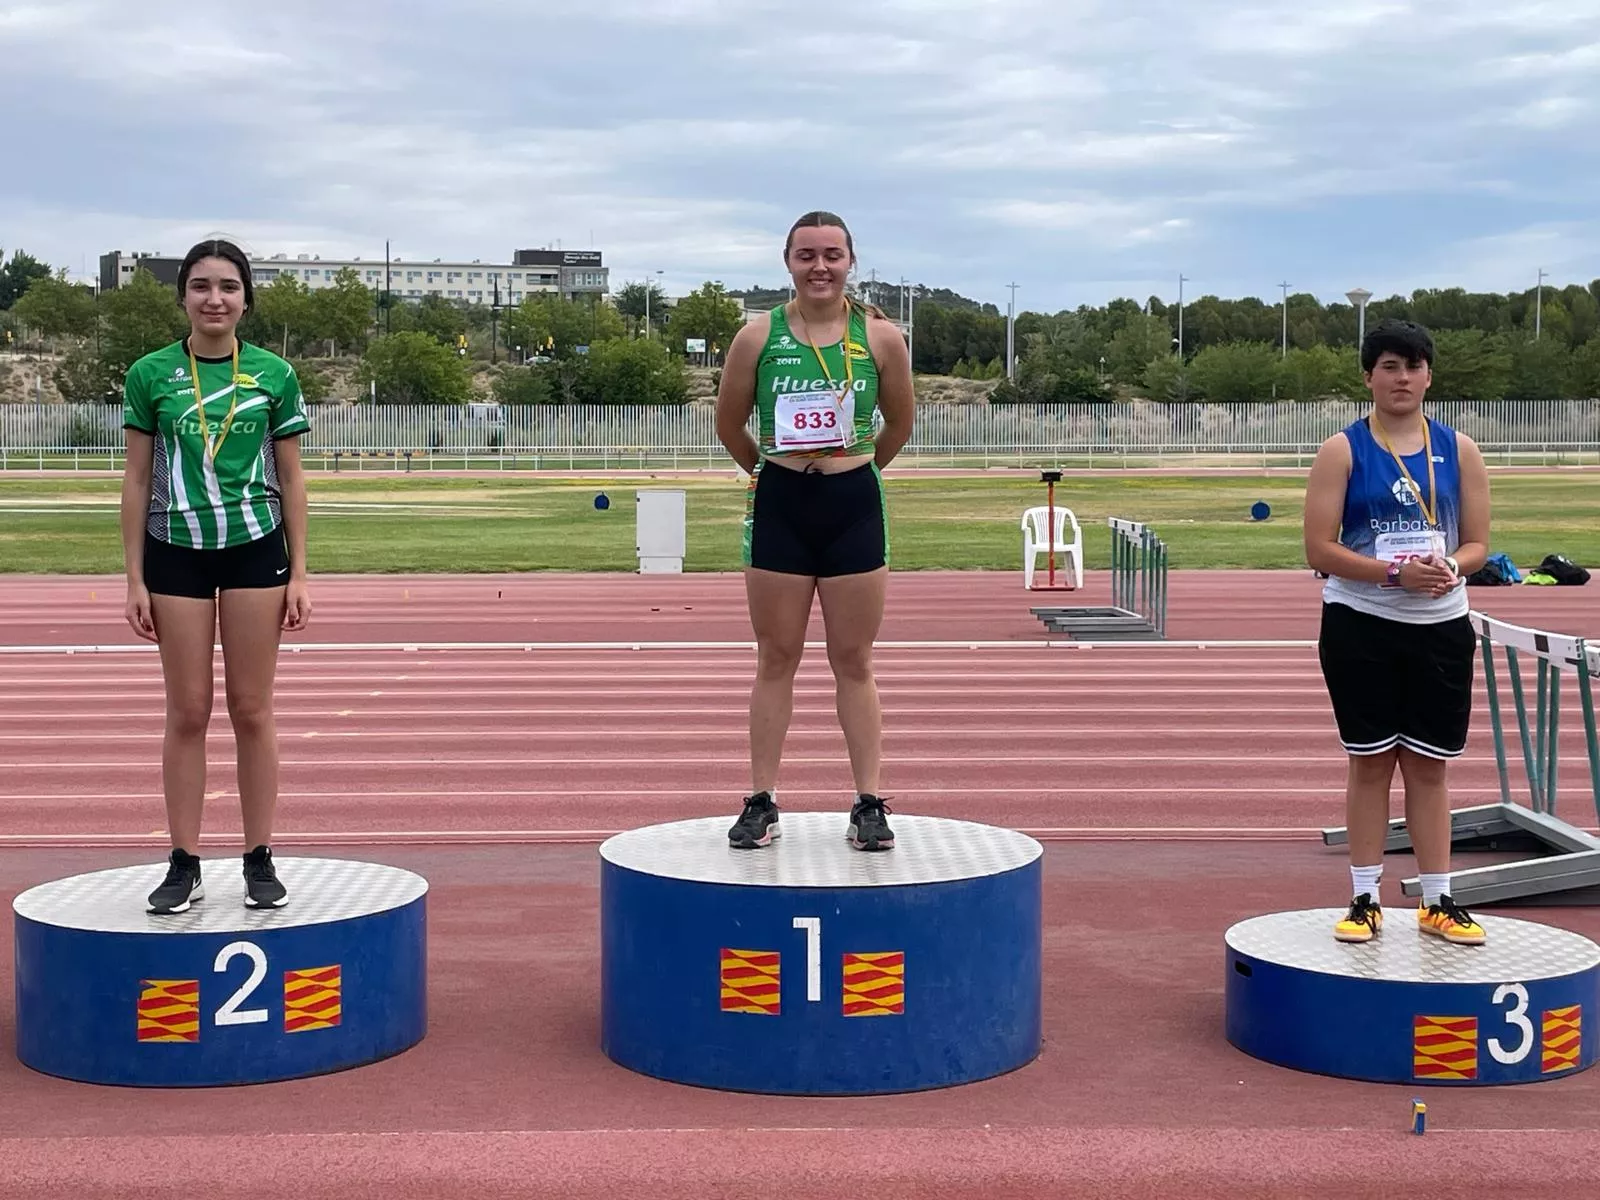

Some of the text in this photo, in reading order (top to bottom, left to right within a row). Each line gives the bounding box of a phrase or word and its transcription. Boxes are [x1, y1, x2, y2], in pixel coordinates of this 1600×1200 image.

[794, 411, 836, 430] 833
[214, 941, 268, 1026] 2
[793, 917, 820, 1001] 1
[1488, 983, 1534, 1065] 3
